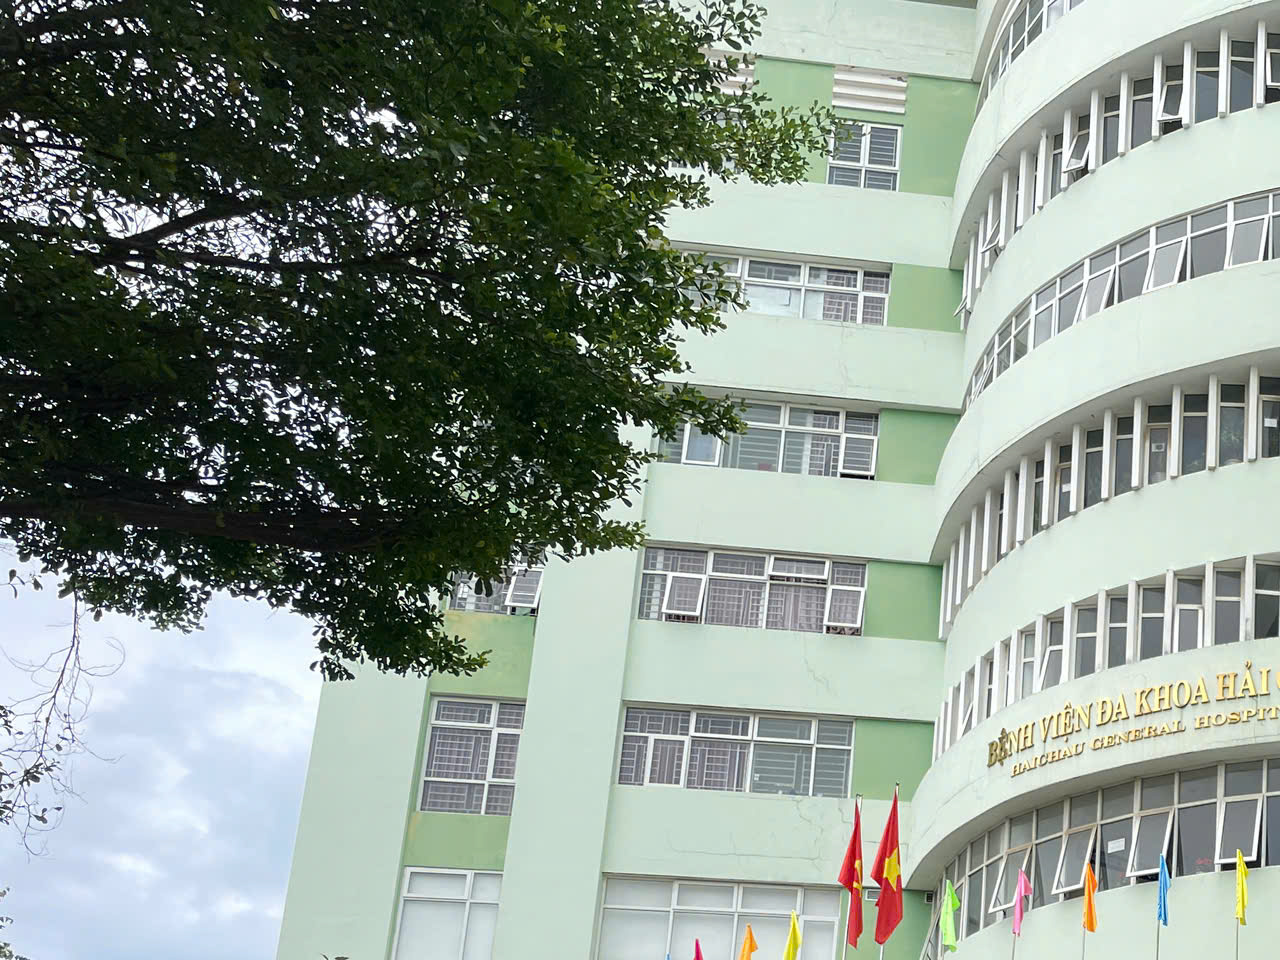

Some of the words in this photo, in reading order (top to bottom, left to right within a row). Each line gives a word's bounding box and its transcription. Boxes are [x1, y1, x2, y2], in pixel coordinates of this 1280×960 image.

[987, 711, 1035, 767] BỆNH
[1038, 701, 1093, 743] VIỆN
[1096, 694, 1130, 727] ĐA
[1134, 676, 1210, 718] KHOA
[1216, 660, 1271, 701] HẢI
[1090, 719, 1186, 751] GENERAL
